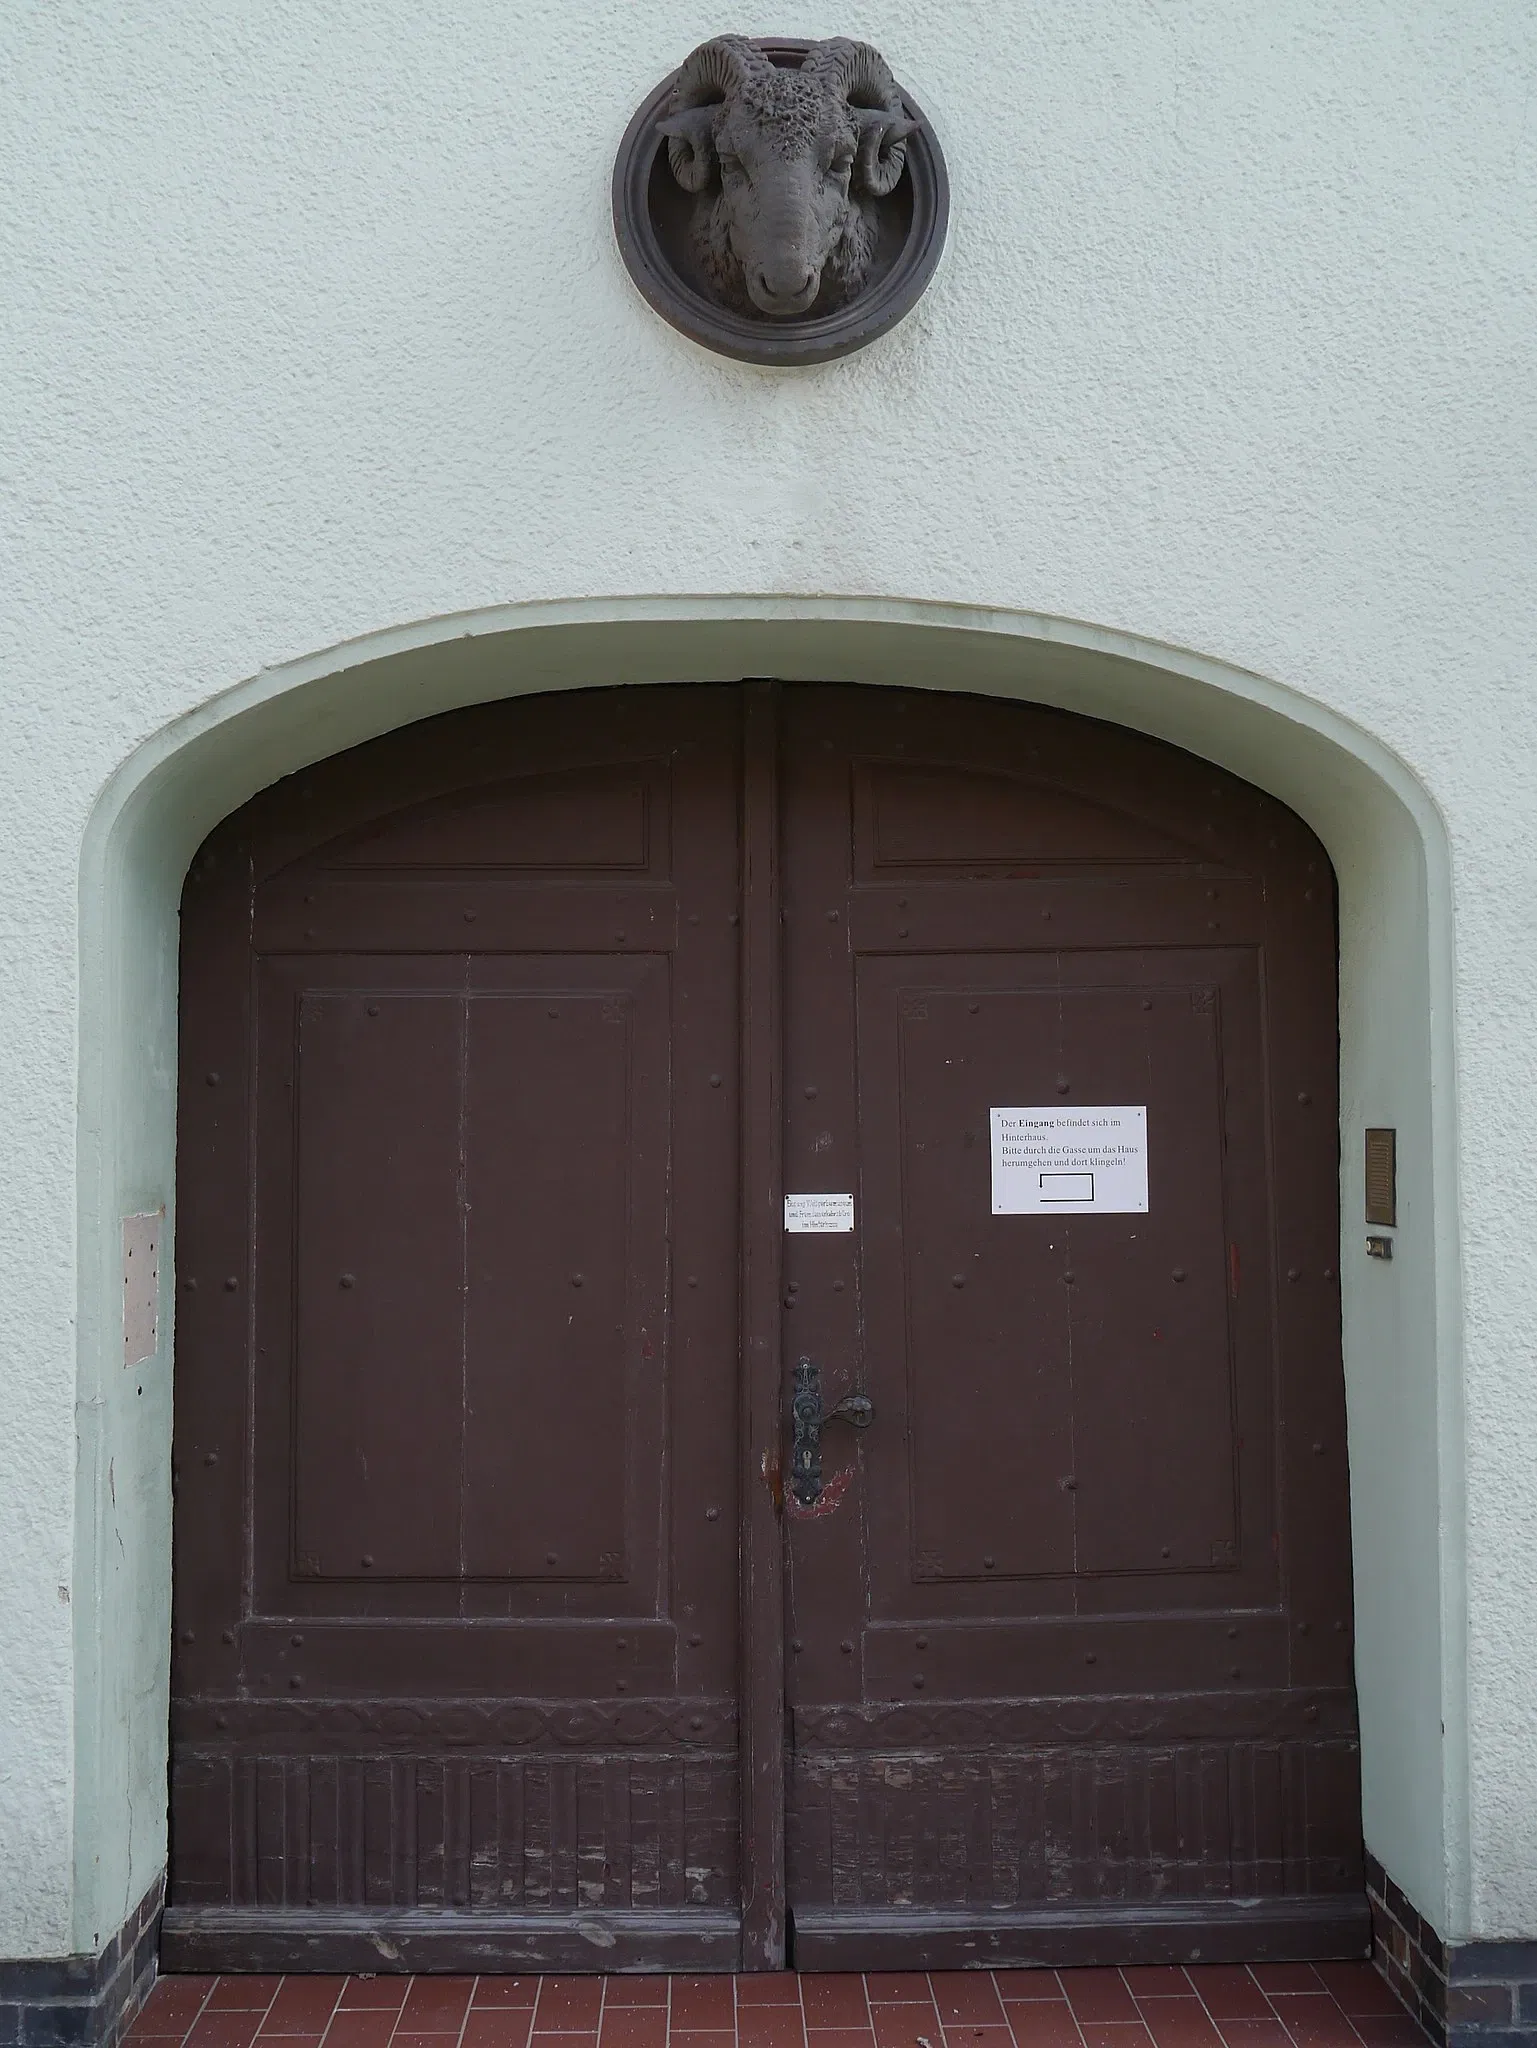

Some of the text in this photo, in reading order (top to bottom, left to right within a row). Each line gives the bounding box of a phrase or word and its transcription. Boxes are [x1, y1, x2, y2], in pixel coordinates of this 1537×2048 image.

[1001, 1118, 1121, 1128] Der Eingang befindet sich im
[1001, 1133, 1048, 1141] Hinterhaus.
[1002, 1146, 1022, 1154] Bitte
[1023, 1146, 1046, 1154] durch
[1048, 1146, 1060, 1154] die
[1062, 1145, 1086, 1154] Gasse
[1102, 1145, 1116, 1153] das
[1117, 1145, 1138, 1153] Haus
[1002, 1157, 1126, 1168] herumgehen und dort klingeln!
